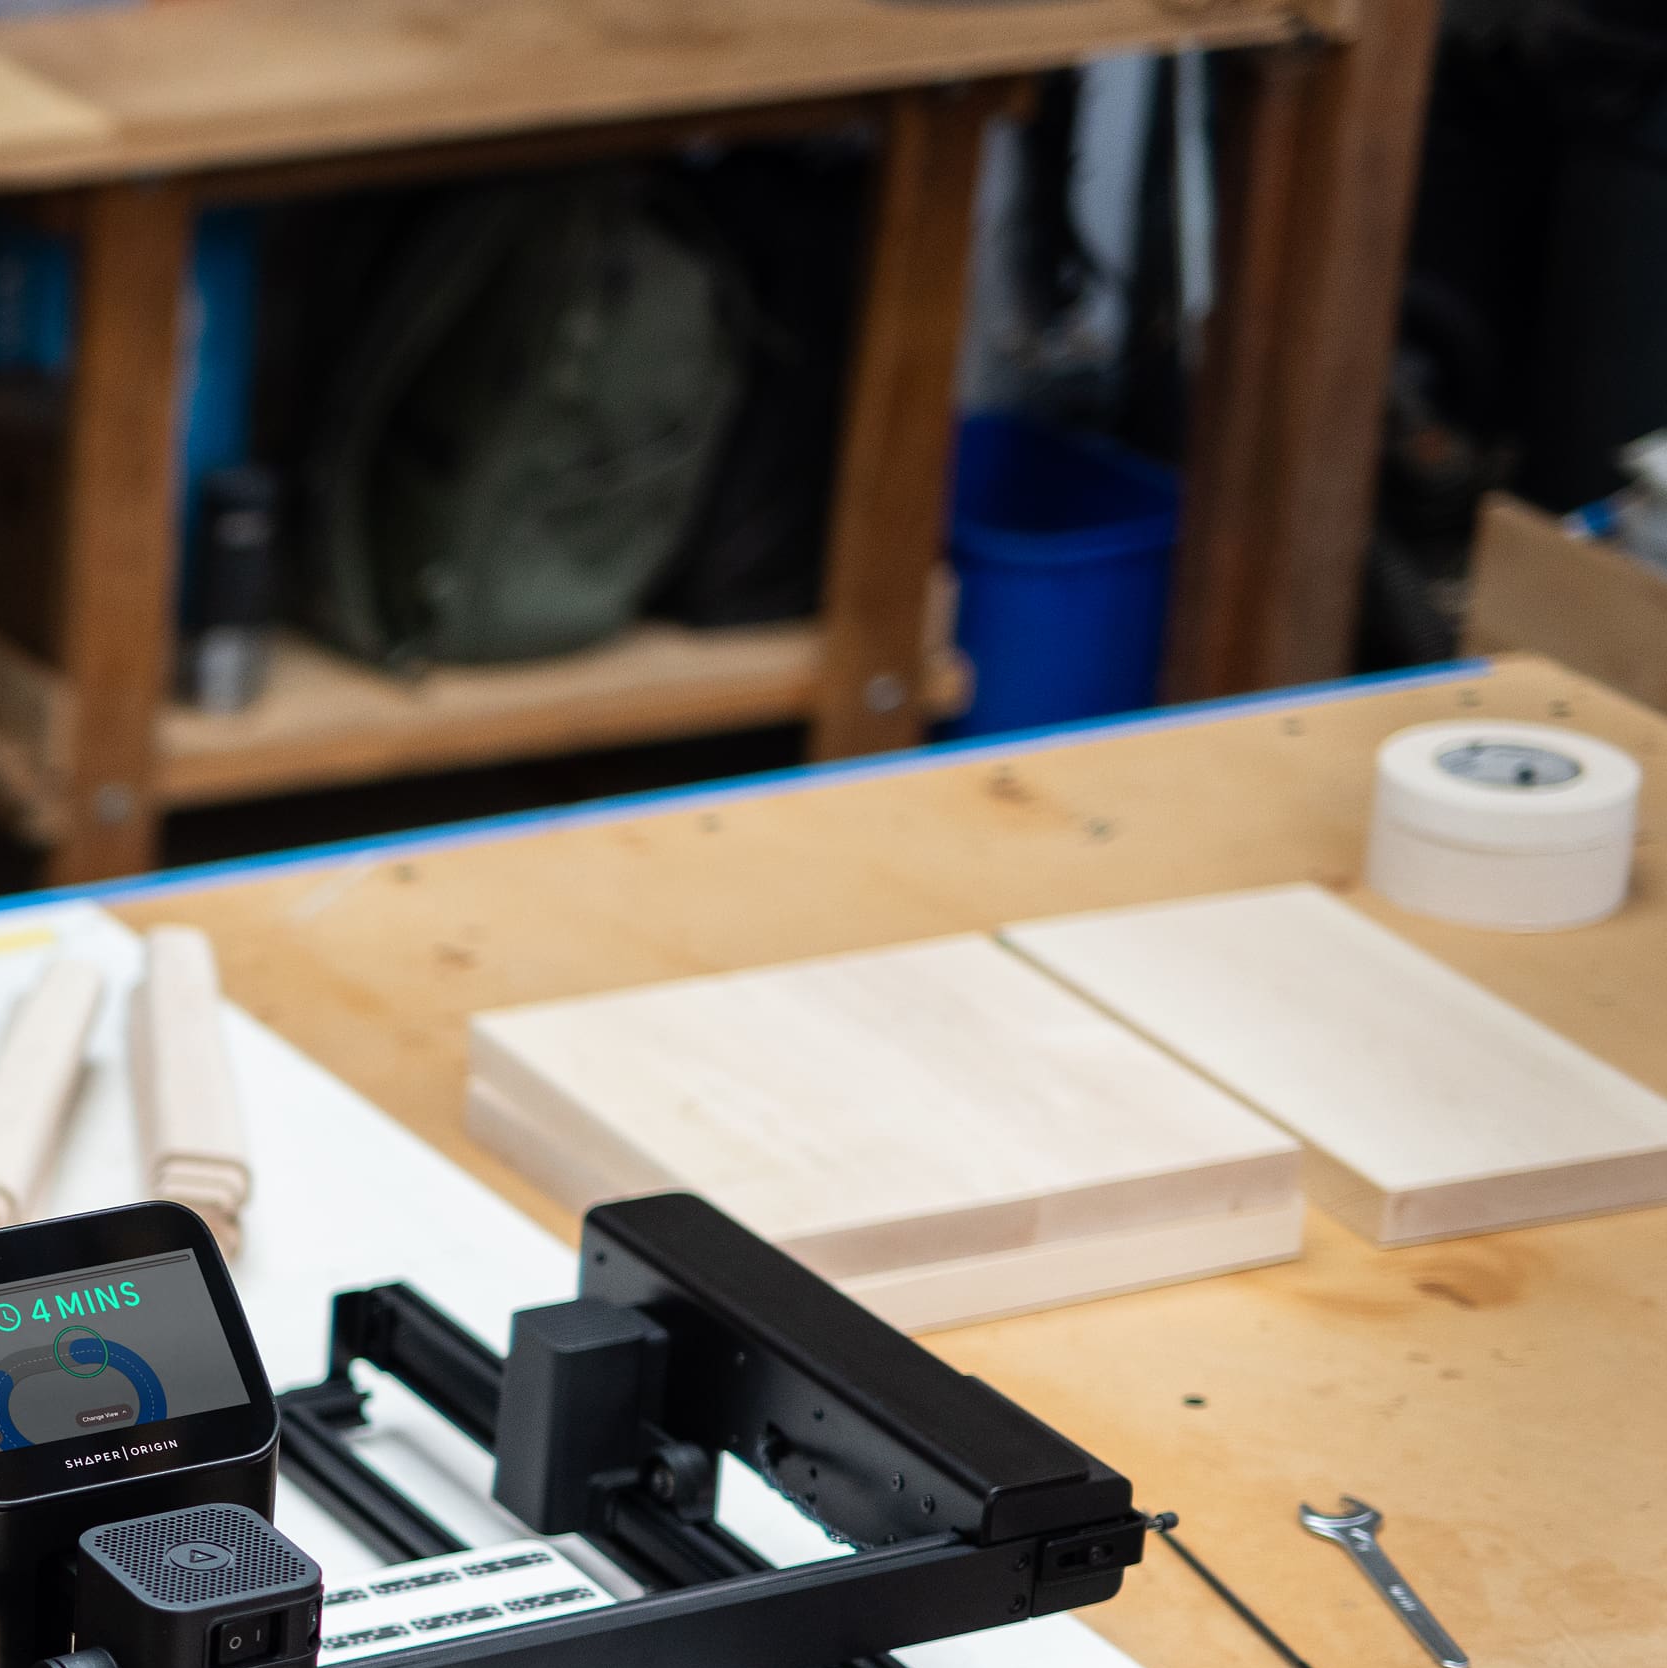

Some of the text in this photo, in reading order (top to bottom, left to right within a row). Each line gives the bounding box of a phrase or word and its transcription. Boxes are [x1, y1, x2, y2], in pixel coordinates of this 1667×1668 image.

[31, 1281, 140, 1323] 4 MINS
[82, 1411, 119, 1424] Change View
[65, 1439, 179, 1469] SHAPER ORIGIN
